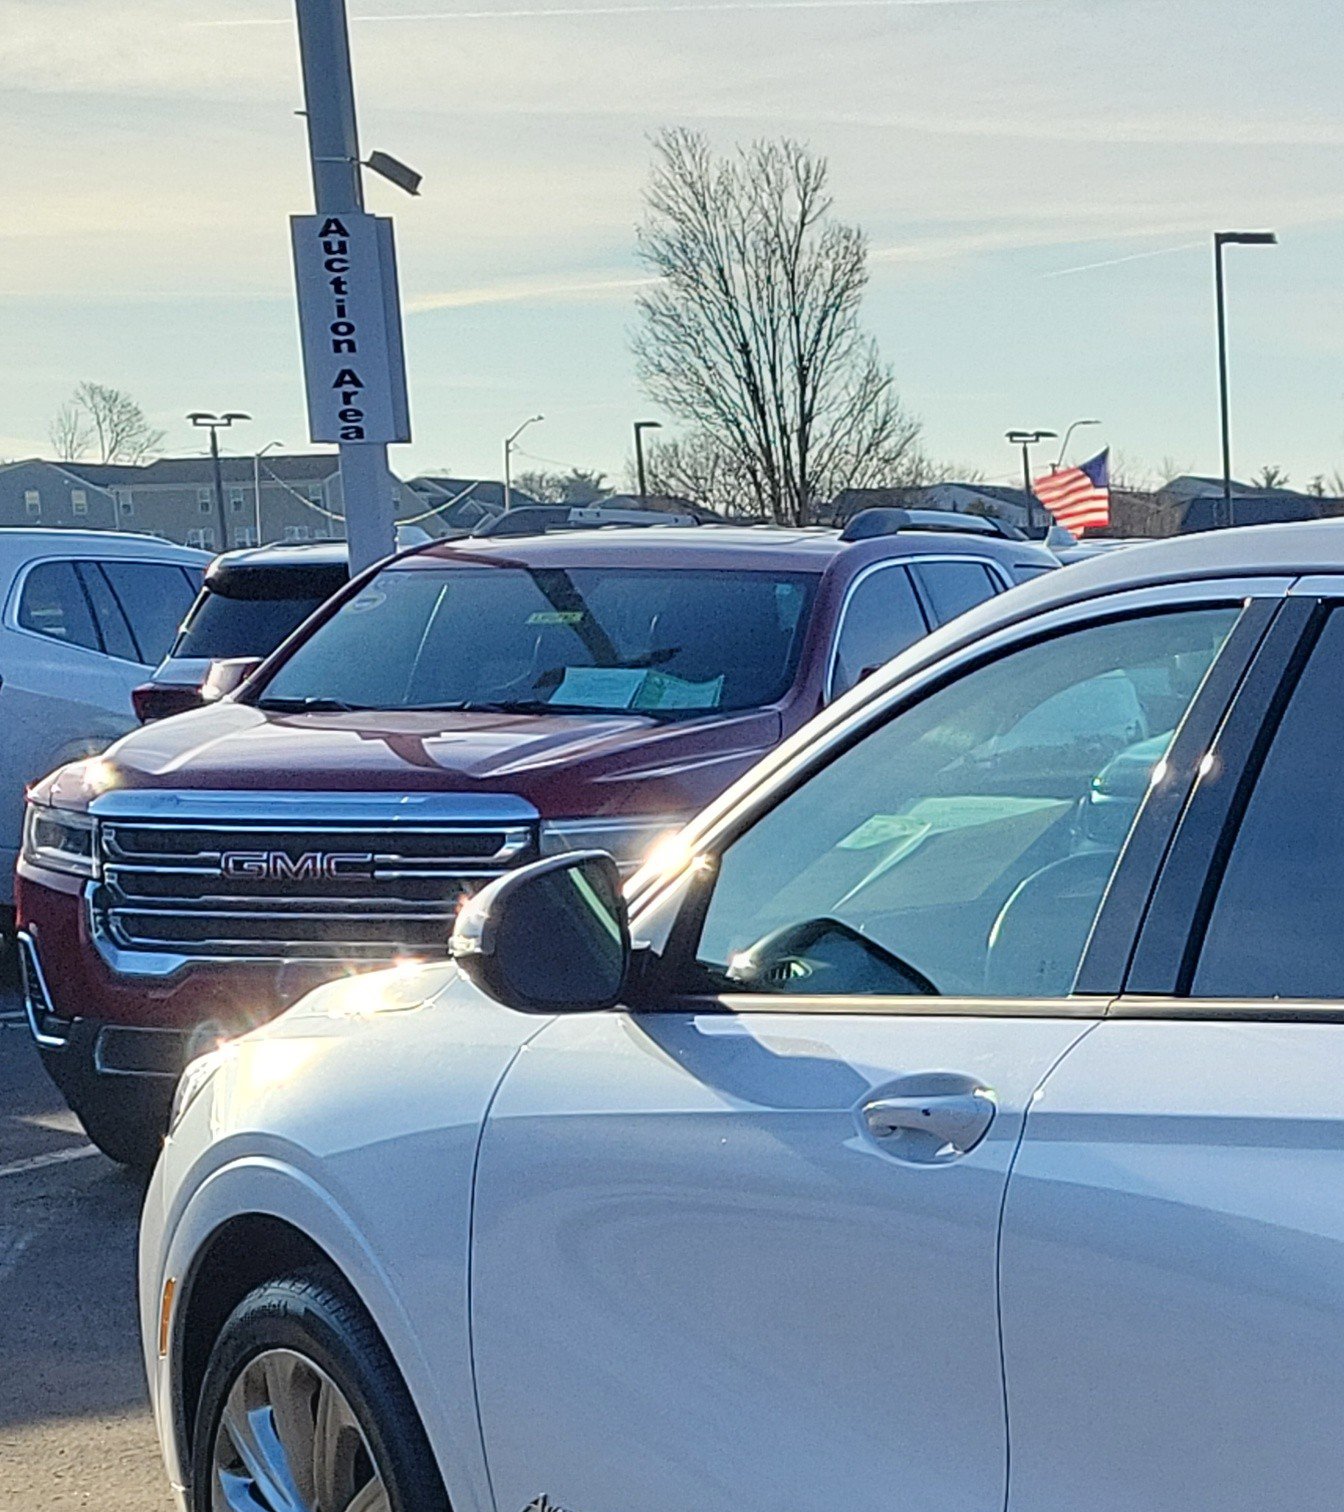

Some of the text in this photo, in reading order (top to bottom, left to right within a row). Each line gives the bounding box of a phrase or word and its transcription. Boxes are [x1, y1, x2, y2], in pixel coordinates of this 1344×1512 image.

[317, 217, 365, 441] Auction Area
[220, 850, 373, 880] GMC
